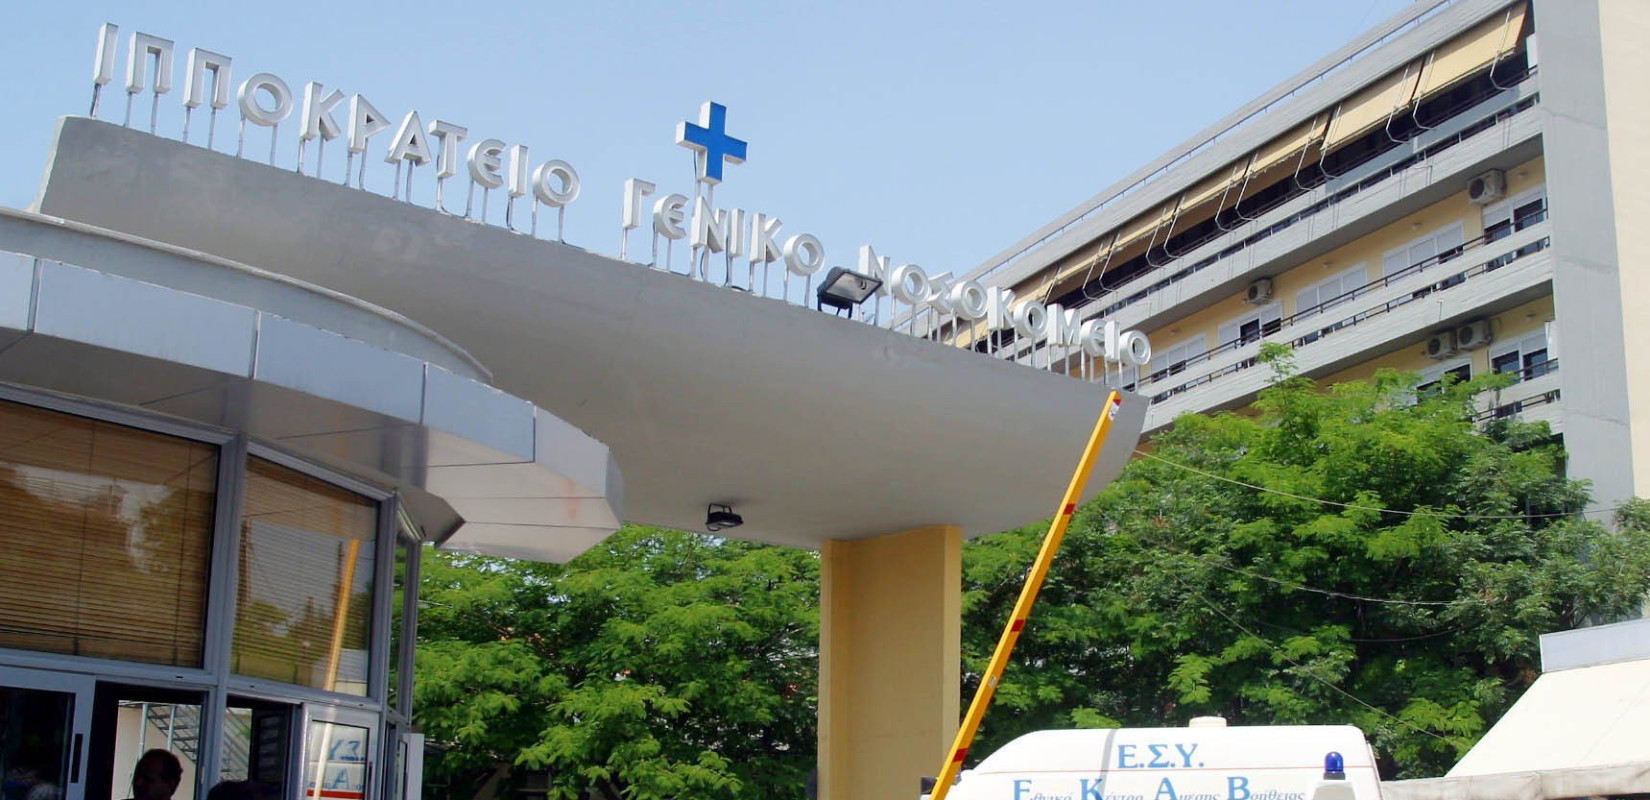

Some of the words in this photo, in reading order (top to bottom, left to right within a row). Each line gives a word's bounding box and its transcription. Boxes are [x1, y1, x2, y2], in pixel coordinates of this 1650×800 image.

[94, 22, 580, 207] ΙΠΠΟΚΡΑΤΕΙΟ
[622, 178, 825, 276] ΓΕΝΙΚΟ
[859, 245, 1151, 366] ΝΟΣΟΚΟΜΕΙΟ
[1117, 743, 1204, 769] Ε.Σ.Υ.
